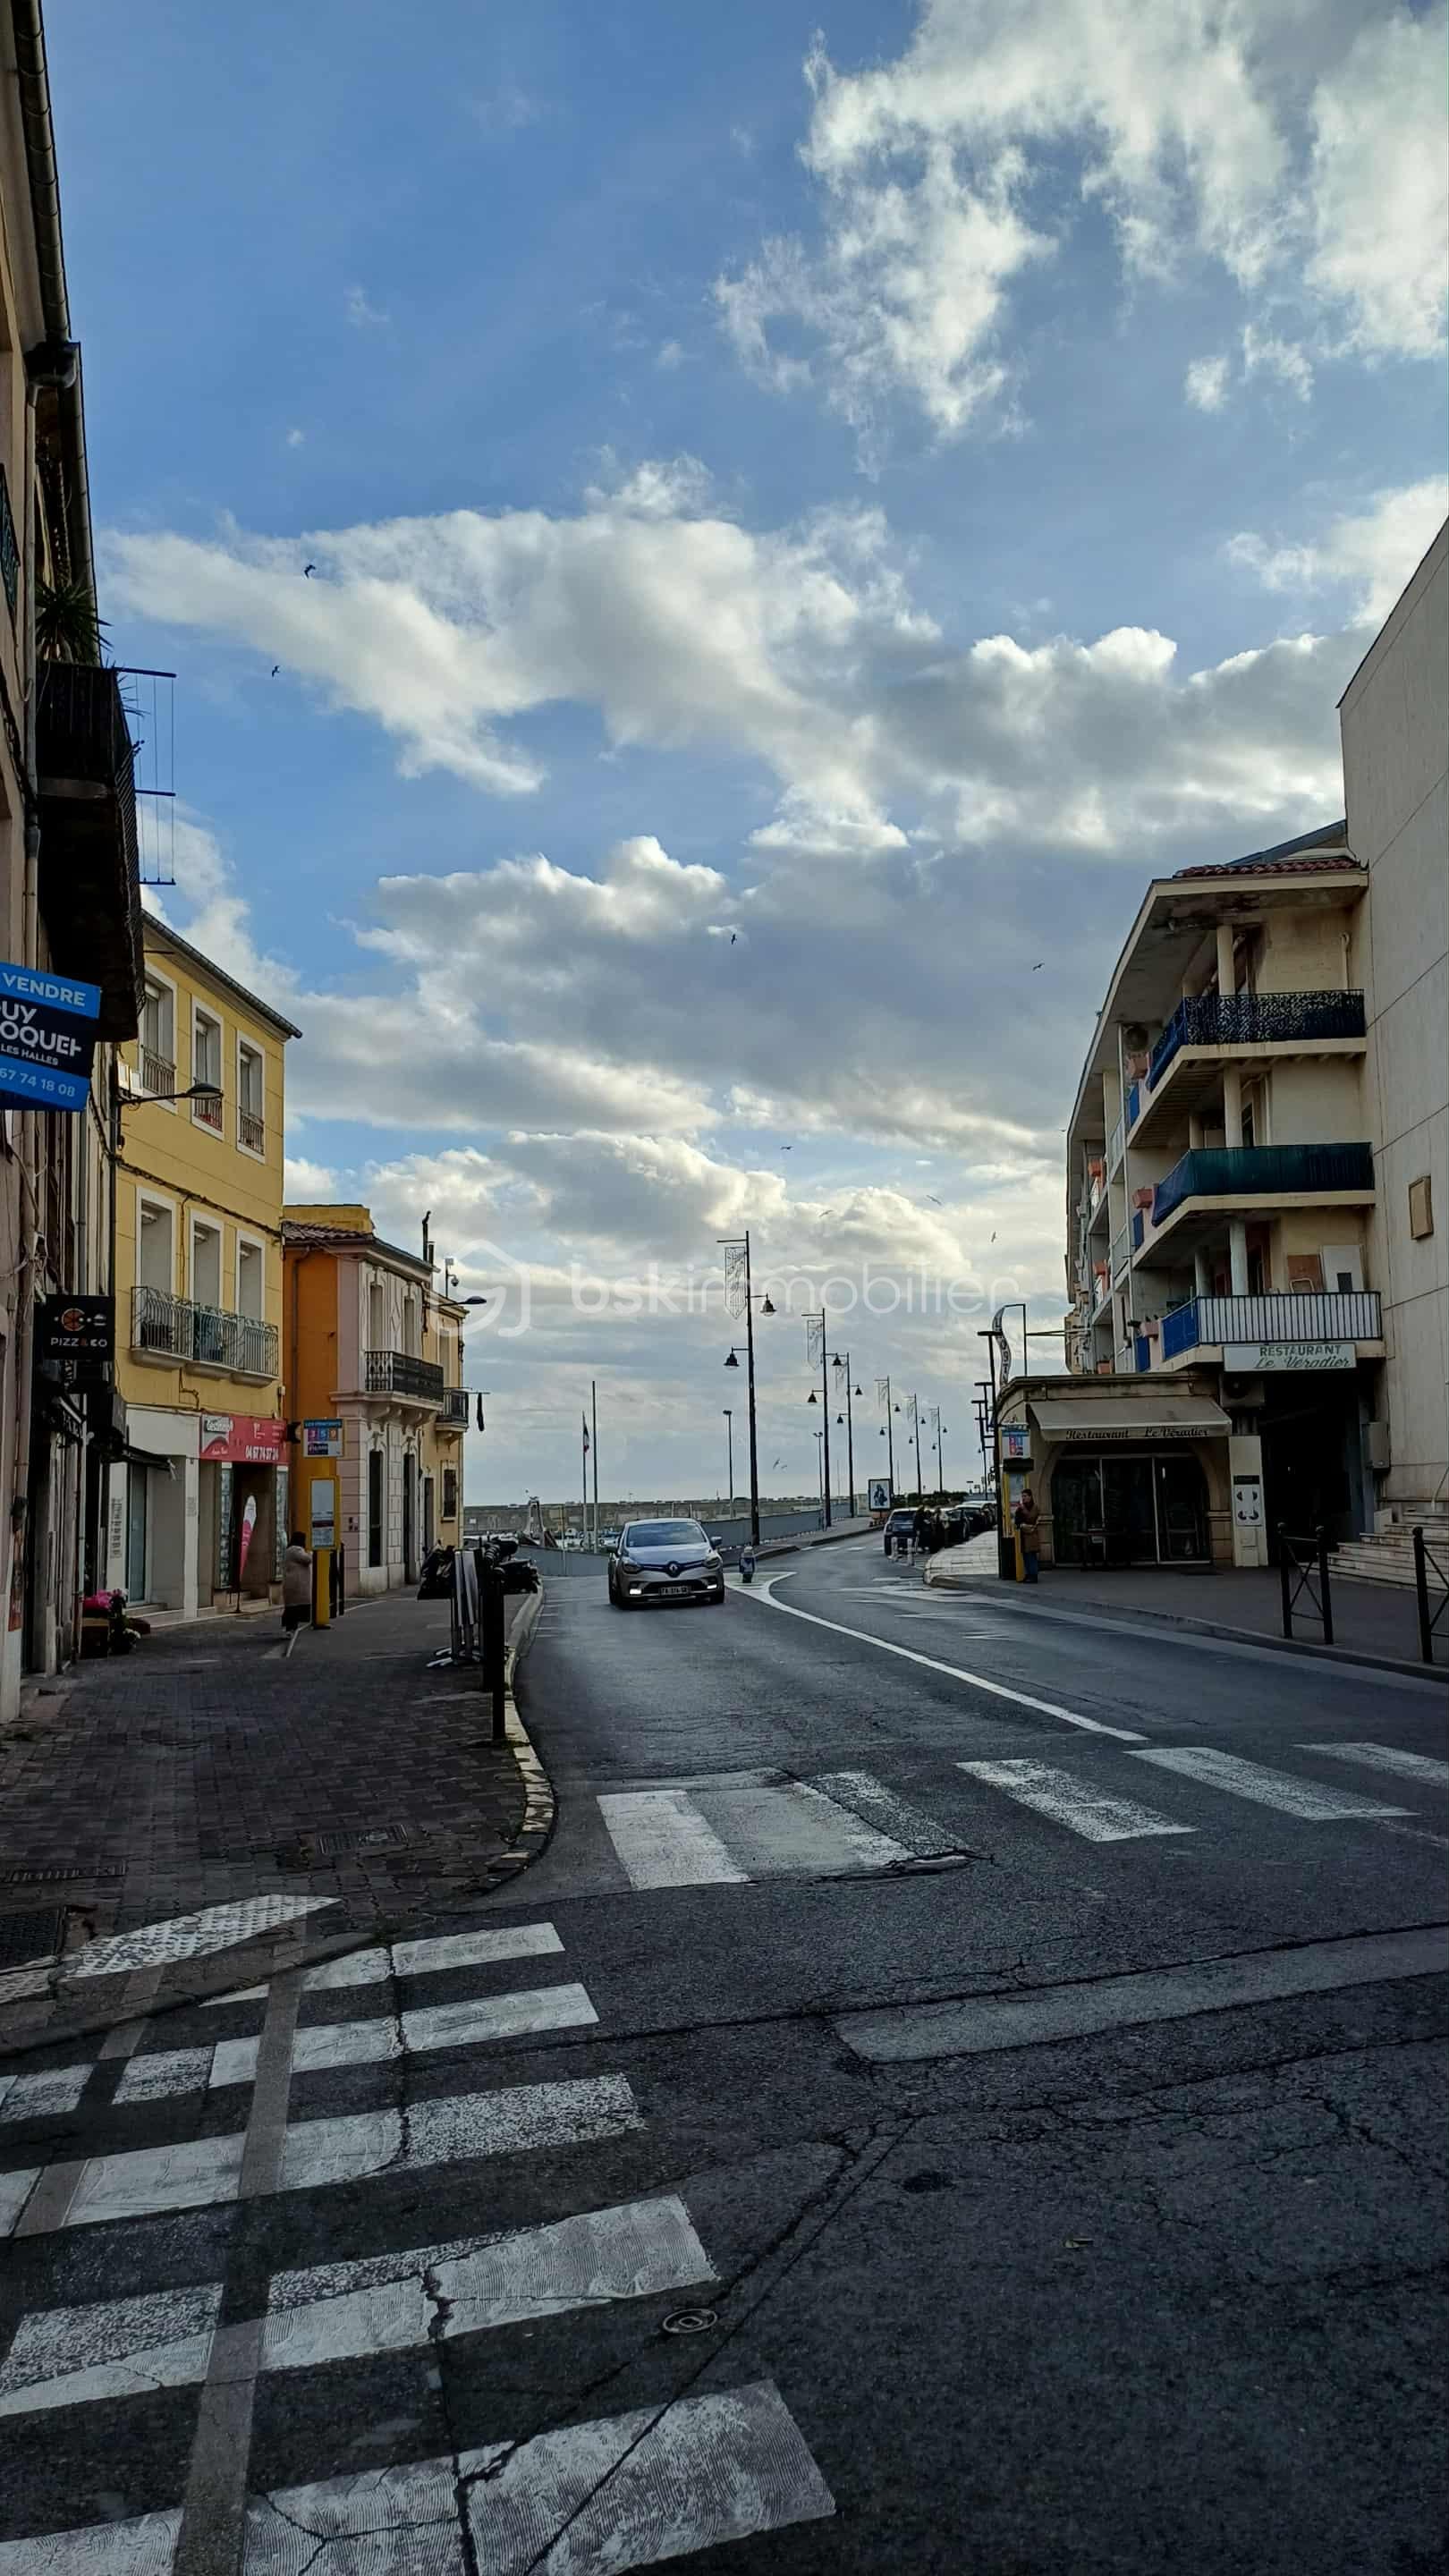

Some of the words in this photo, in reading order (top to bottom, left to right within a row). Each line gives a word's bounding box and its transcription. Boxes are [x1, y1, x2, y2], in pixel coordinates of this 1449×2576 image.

[3, 973, 87, 1006] VENDRE
[0, 1000, 37, 1023] UY
[1, 1043, 19, 1055] LES
[21, 1049, 59, 1065] HALLES
[20, 1072, 37, 1087] 74
[40, 1078, 55, 1091] 18
[57, 1083, 76, 1097] 08
[1259, 1344, 1342, 1357] RESTAURANT
[1253, 1356, 1275, 1368] Le
[1066, 1429, 1129, 1440] Restaurant
[1144, 1427, 1160, 1438] Le
